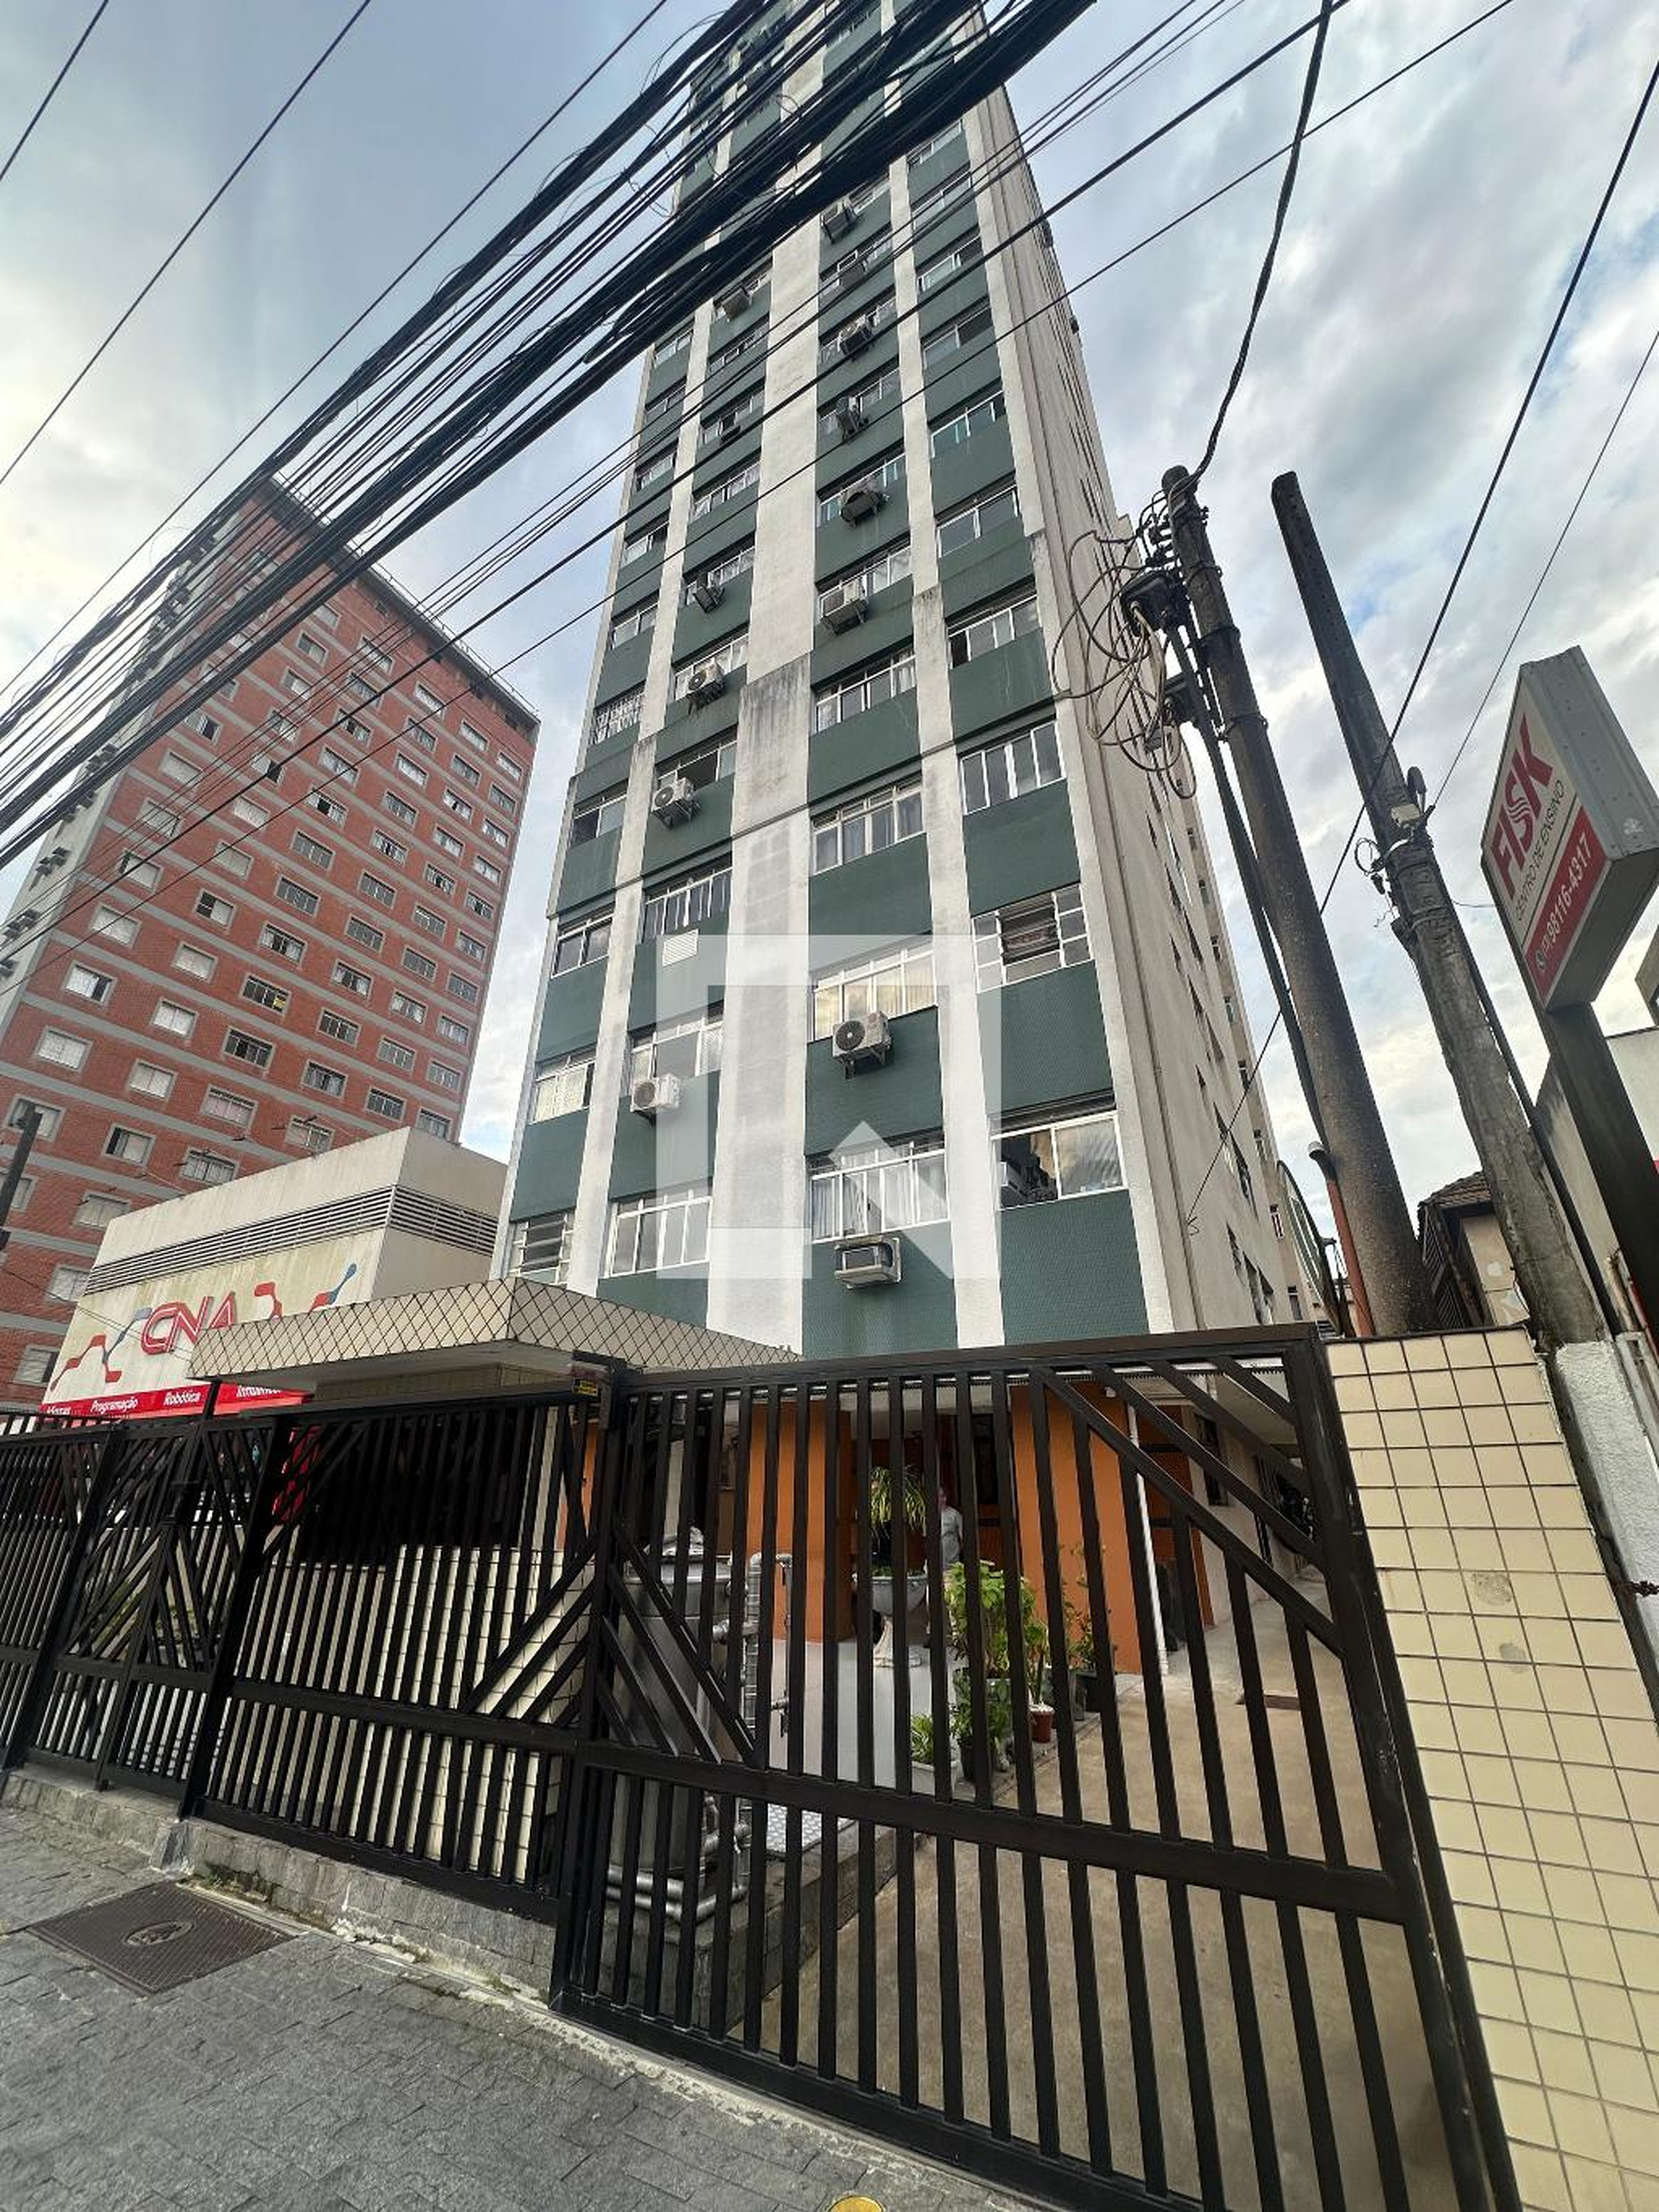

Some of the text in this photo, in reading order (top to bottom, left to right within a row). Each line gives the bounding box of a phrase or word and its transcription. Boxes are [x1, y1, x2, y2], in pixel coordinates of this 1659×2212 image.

[1491, 712, 1554, 901] FISK
[1516, 779, 1564, 921] CENTRO DE ENSINO
[141, 1291, 235, 1355] CNA
[90, 1396, 138, 1414] Programação
[163, 1390, 201, 1405] Robótica
